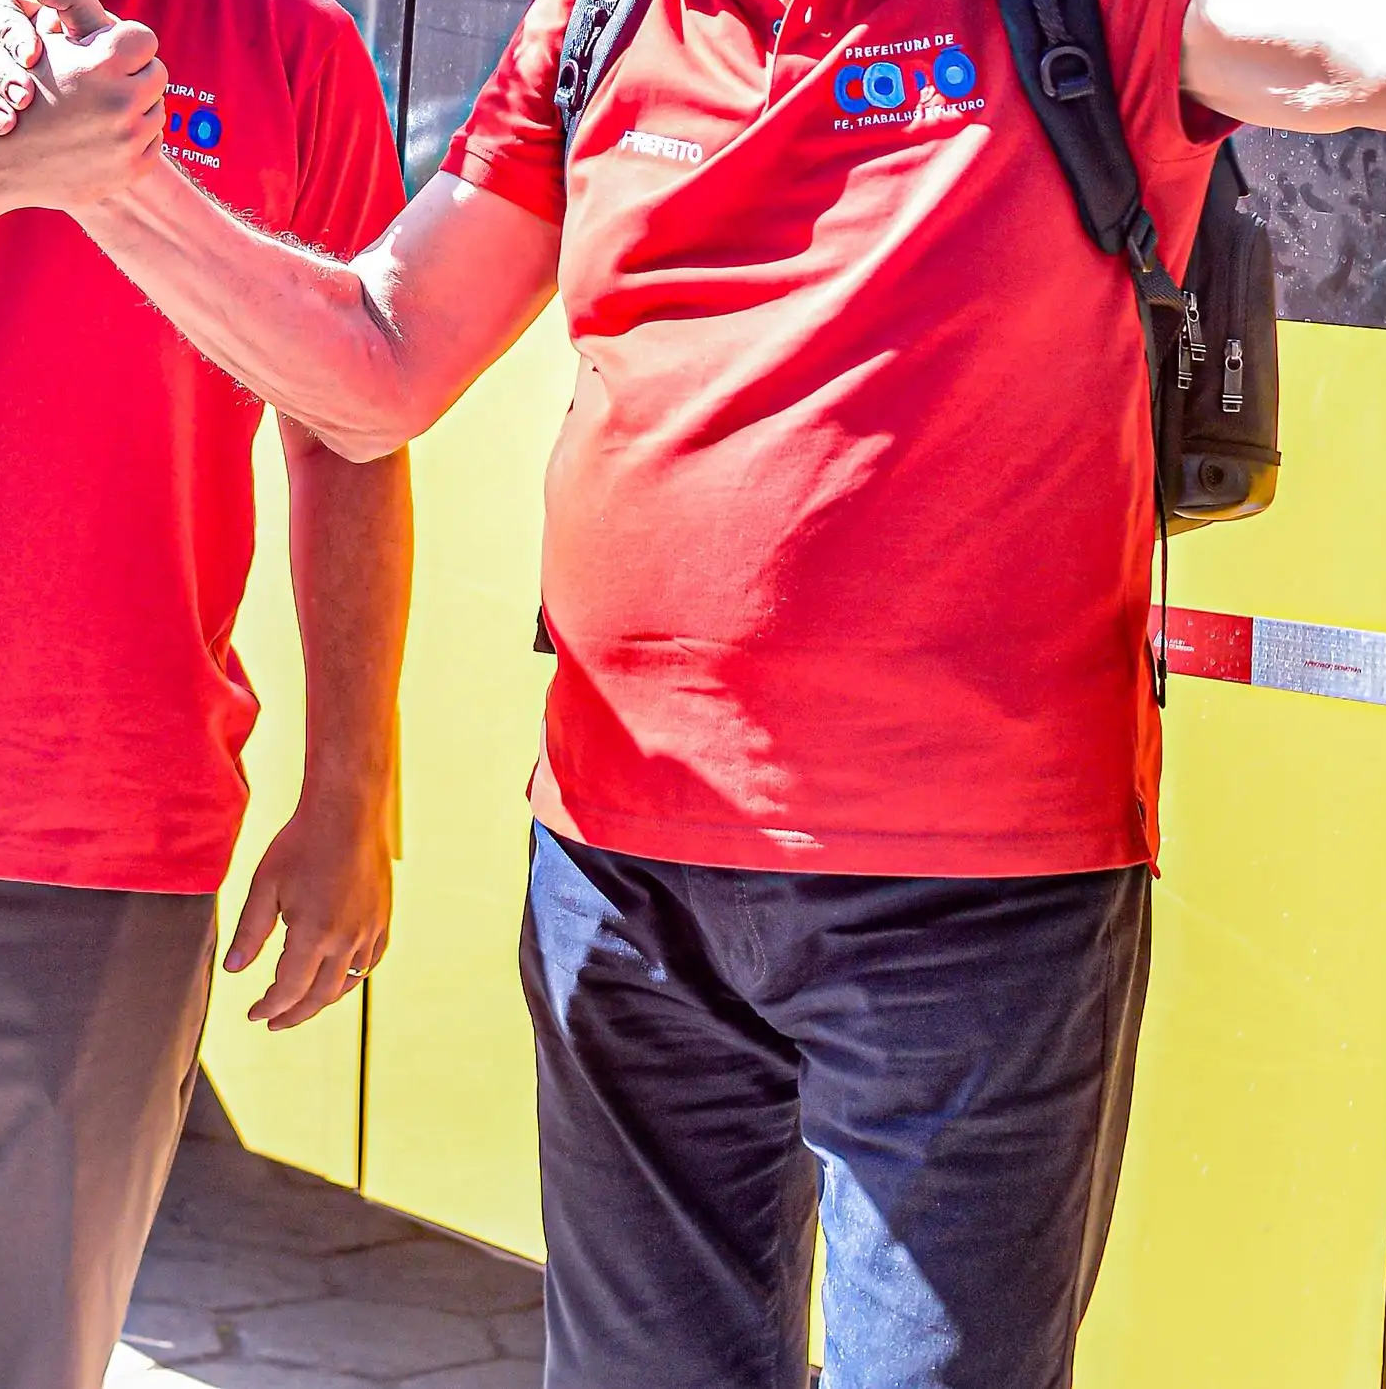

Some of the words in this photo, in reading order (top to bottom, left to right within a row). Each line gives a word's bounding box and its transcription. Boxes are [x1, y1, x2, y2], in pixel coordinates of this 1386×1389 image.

[845, 39, 931, 60] PREFEITURA
[934, 33, 955, 47] DE
[198, 90, 216, 104] DE
[857, 110, 922, 127] TRABALHO
[935, 98, 985, 118] FUTURO
[182, 149, 220, 169] FUTURO
[620, 130, 703, 163] PREFEITO
